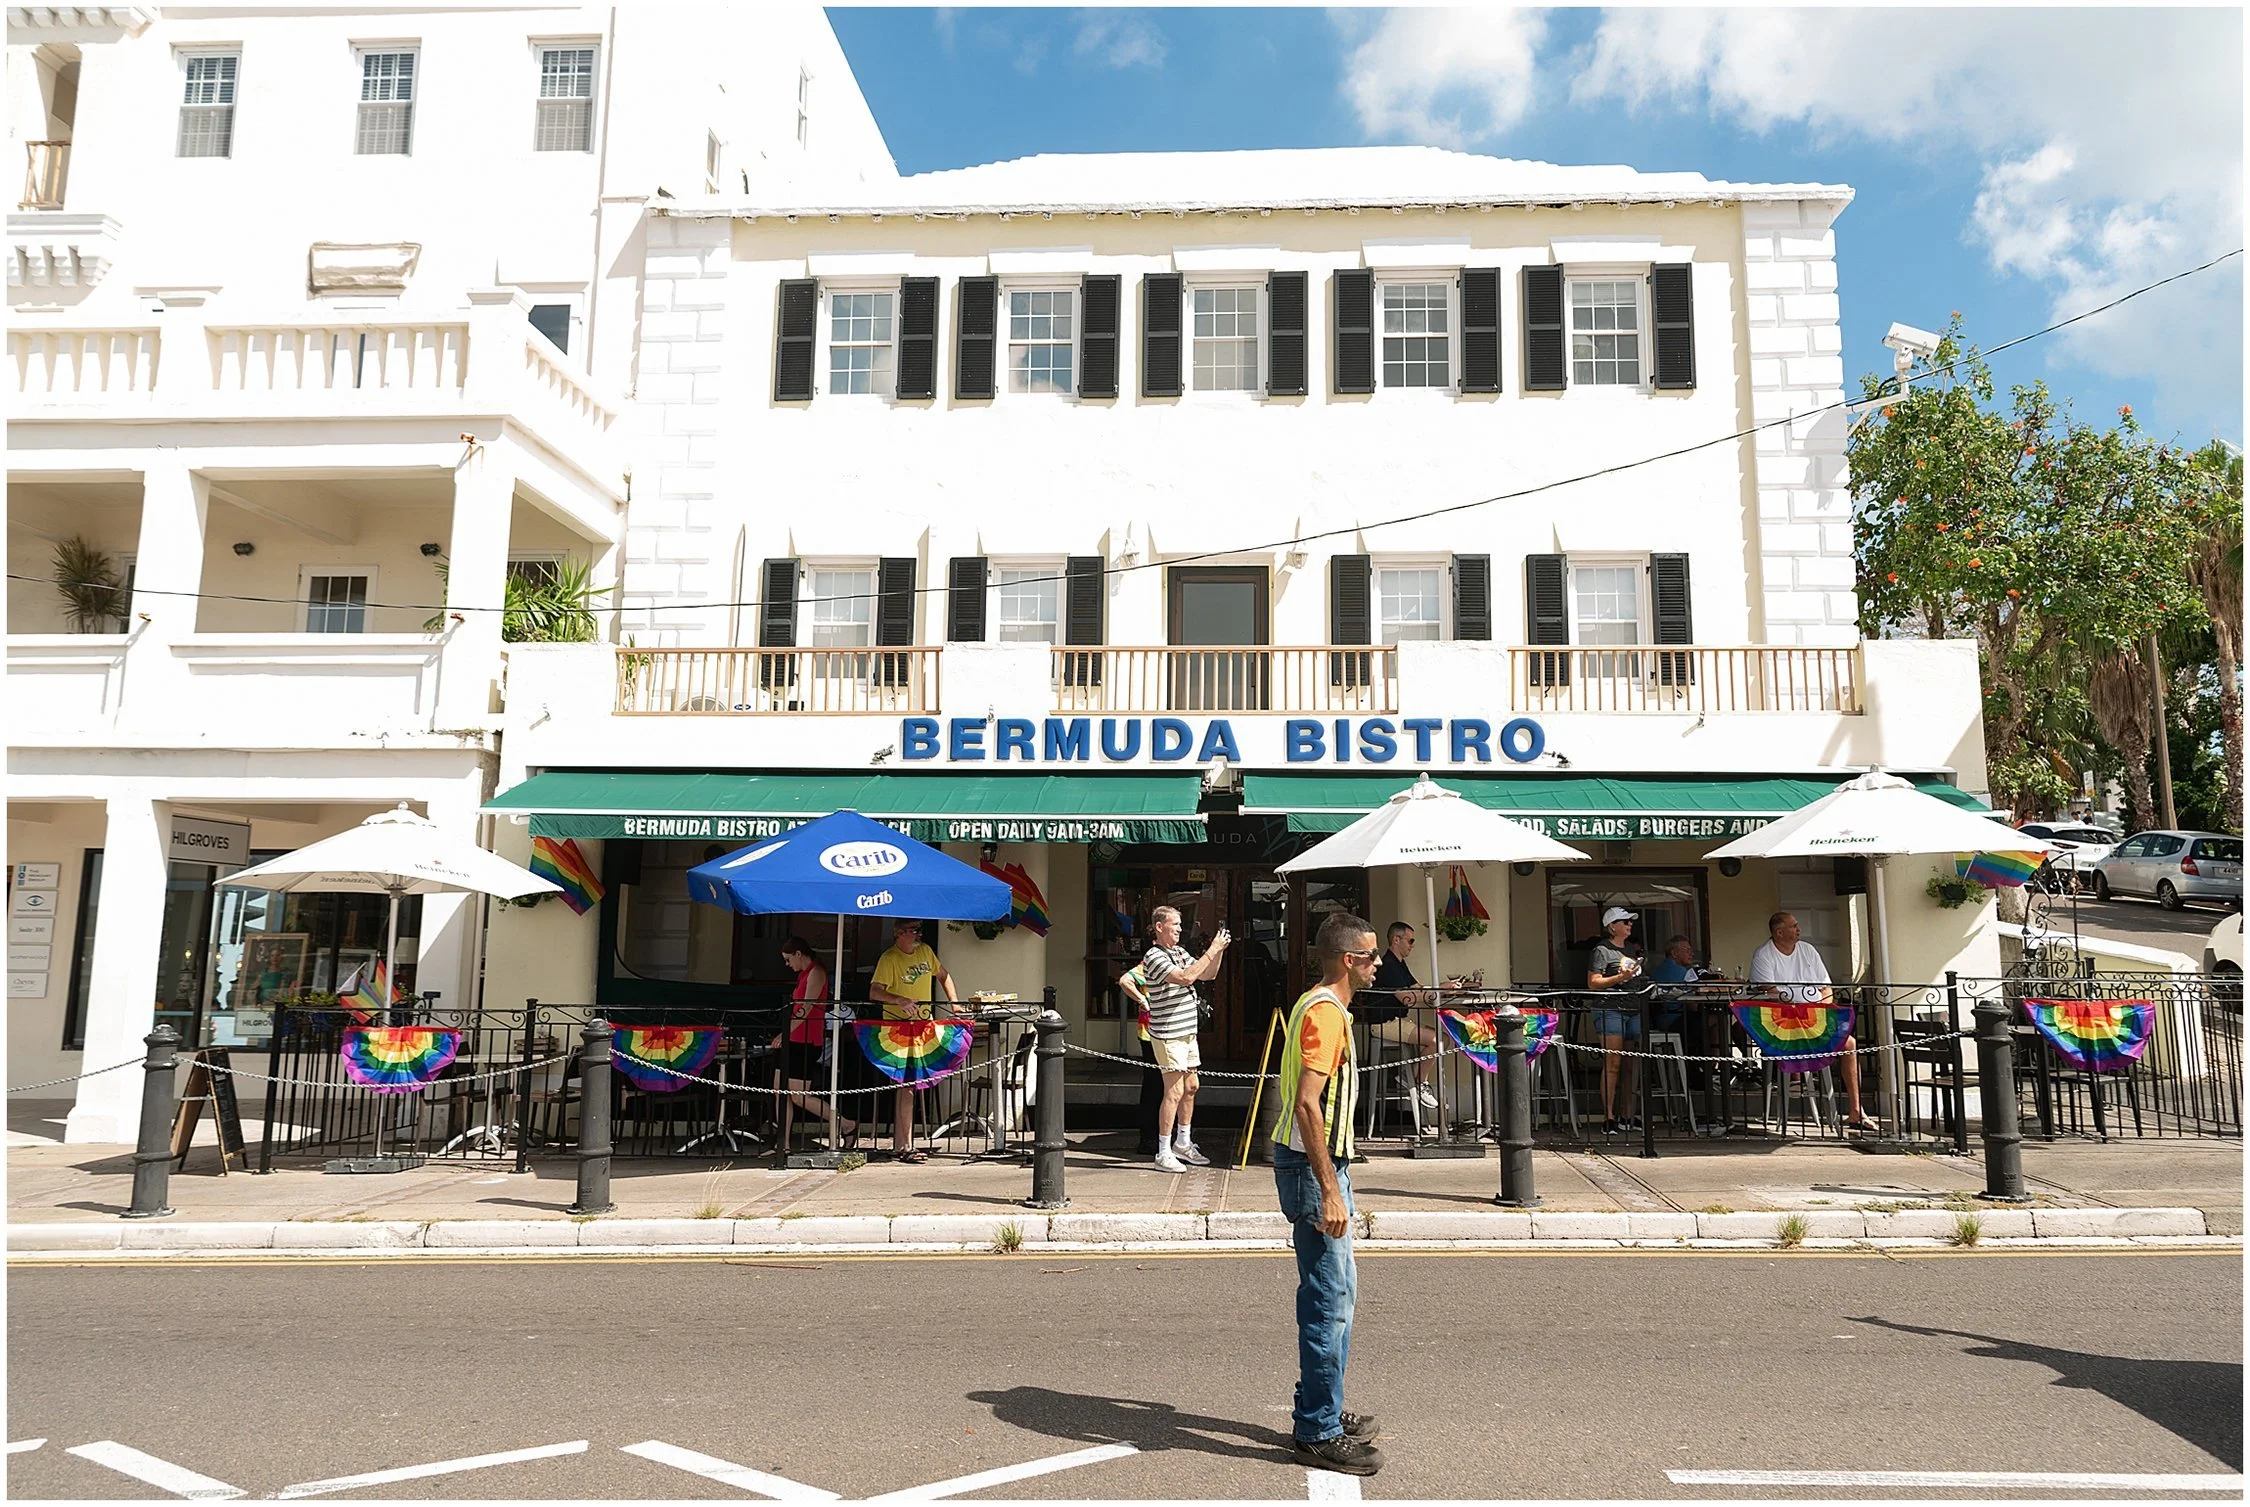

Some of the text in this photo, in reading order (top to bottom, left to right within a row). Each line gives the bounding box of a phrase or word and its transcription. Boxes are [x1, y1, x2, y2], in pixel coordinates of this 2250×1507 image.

[903, 717, 1548, 764] BERMUDA BISTRO
[624, 818, 711, 836] BERMUDA
[717, 819, 781, 837] BISTRO
[948, 821, 1125, 840] OPEN DAILY 9AM-3AM
[1557, 818, 1633, 838] SALADS,
[1639, 818, 1726, 837] BURGERS
[171, 830, 230, 850] HILGROVES
[1400, 845, 1462, 854] Heineken
[1809, 835, 1876, 846] Heineken
[830, 849, 897, 869] Carib
[413, 863, 471, 879] Heineken
[856, 889, 894, 910] Carib
